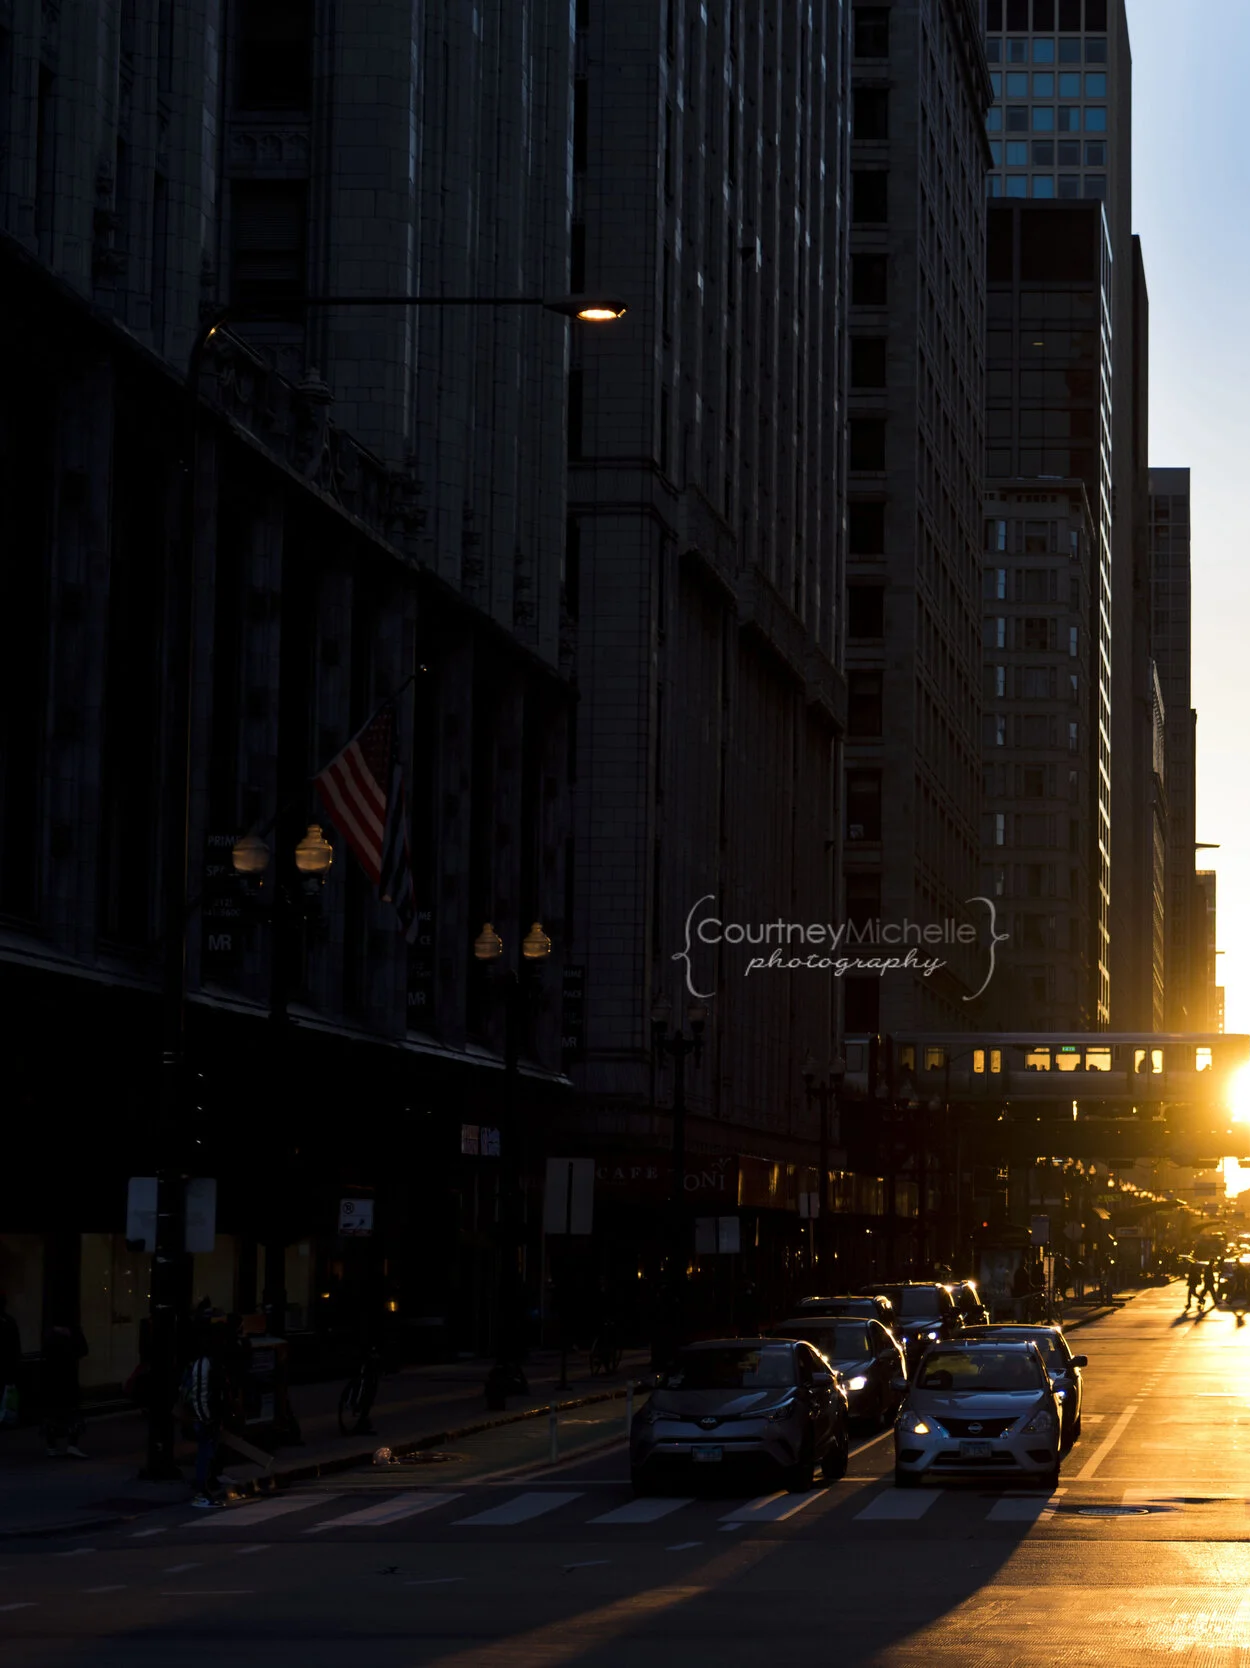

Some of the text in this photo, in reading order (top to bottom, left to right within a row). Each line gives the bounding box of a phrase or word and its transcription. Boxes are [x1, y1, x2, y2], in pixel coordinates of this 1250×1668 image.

[208, 934, 232, 951] MR
[408, 991, 426, 1006] MR
[683, 1171, 726, 1192] ONI
